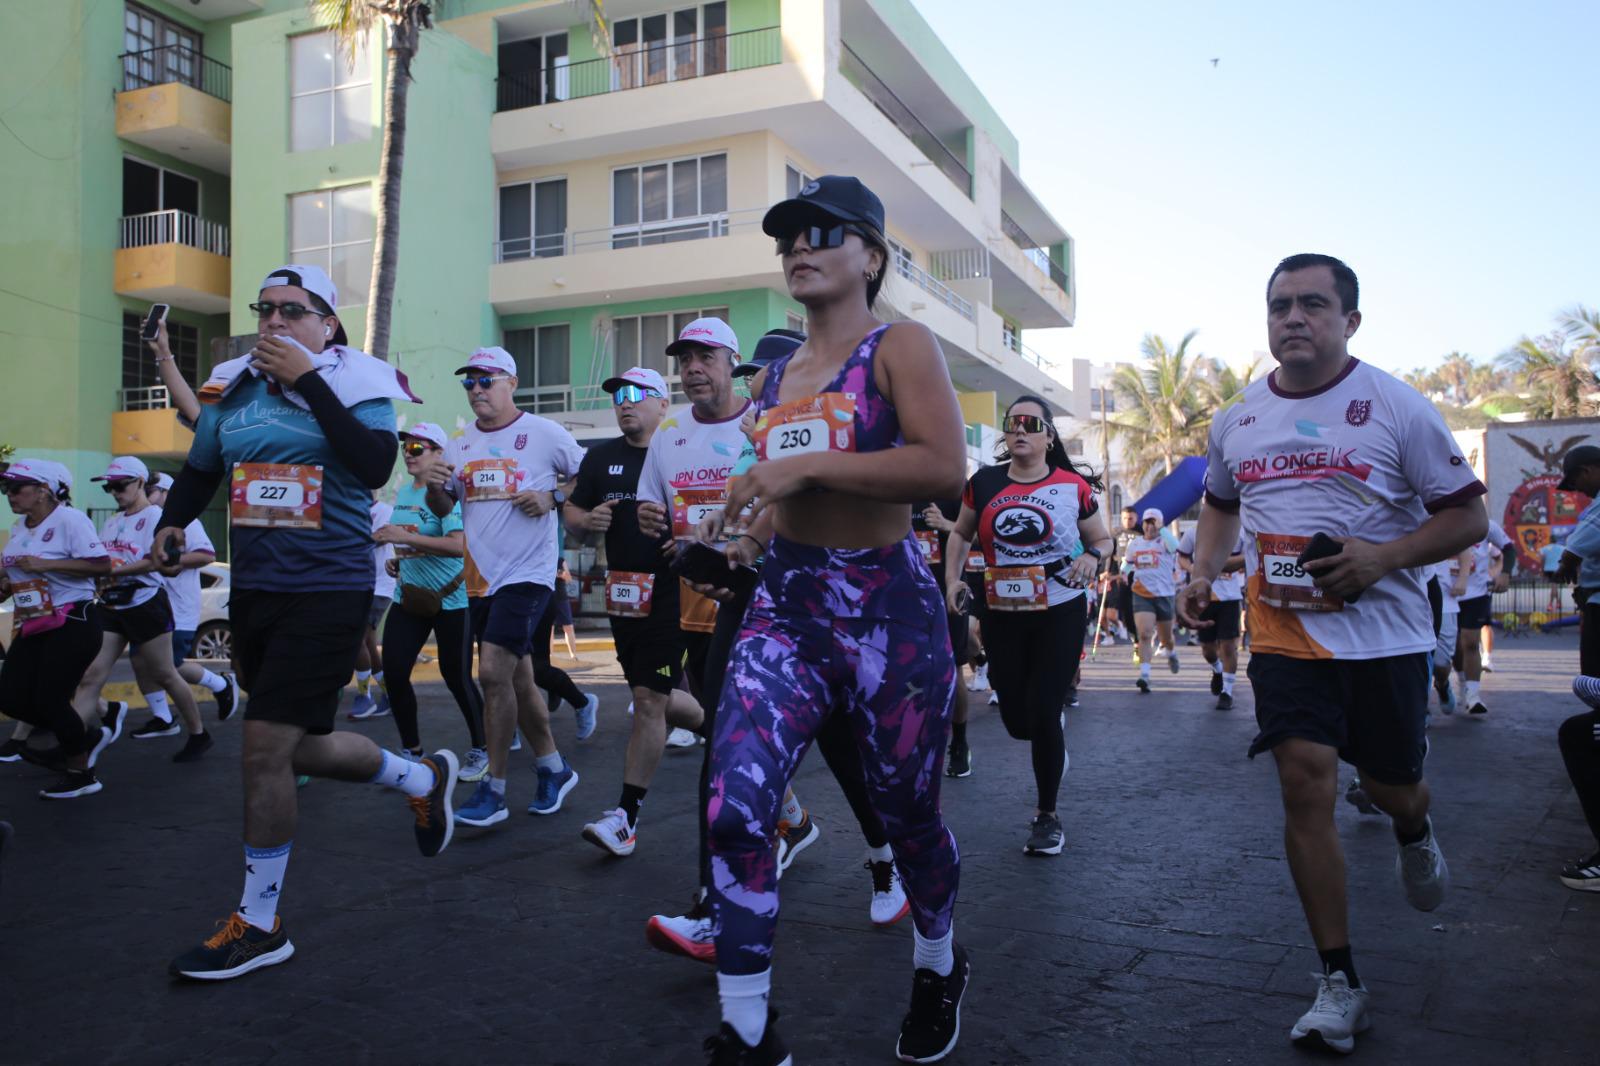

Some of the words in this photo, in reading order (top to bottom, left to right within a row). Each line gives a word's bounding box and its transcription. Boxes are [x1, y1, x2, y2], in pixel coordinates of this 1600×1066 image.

[779, 428, 812, 450] 230
[1238, 457, 1267, 476] IPN
[1271, 451, 1328, 472] ONCE
[479, 473, 496, 483] 214
[675, 470, 694, 483] IPN
[259, 486, 288, 500] 227
[990, 495, 1055, 511] DEPORTIVO
[991, 542, 1056, 559] DRAGONES
[616, 587, 631, 598] 301
[1006, 583, 1021, 593] 70
